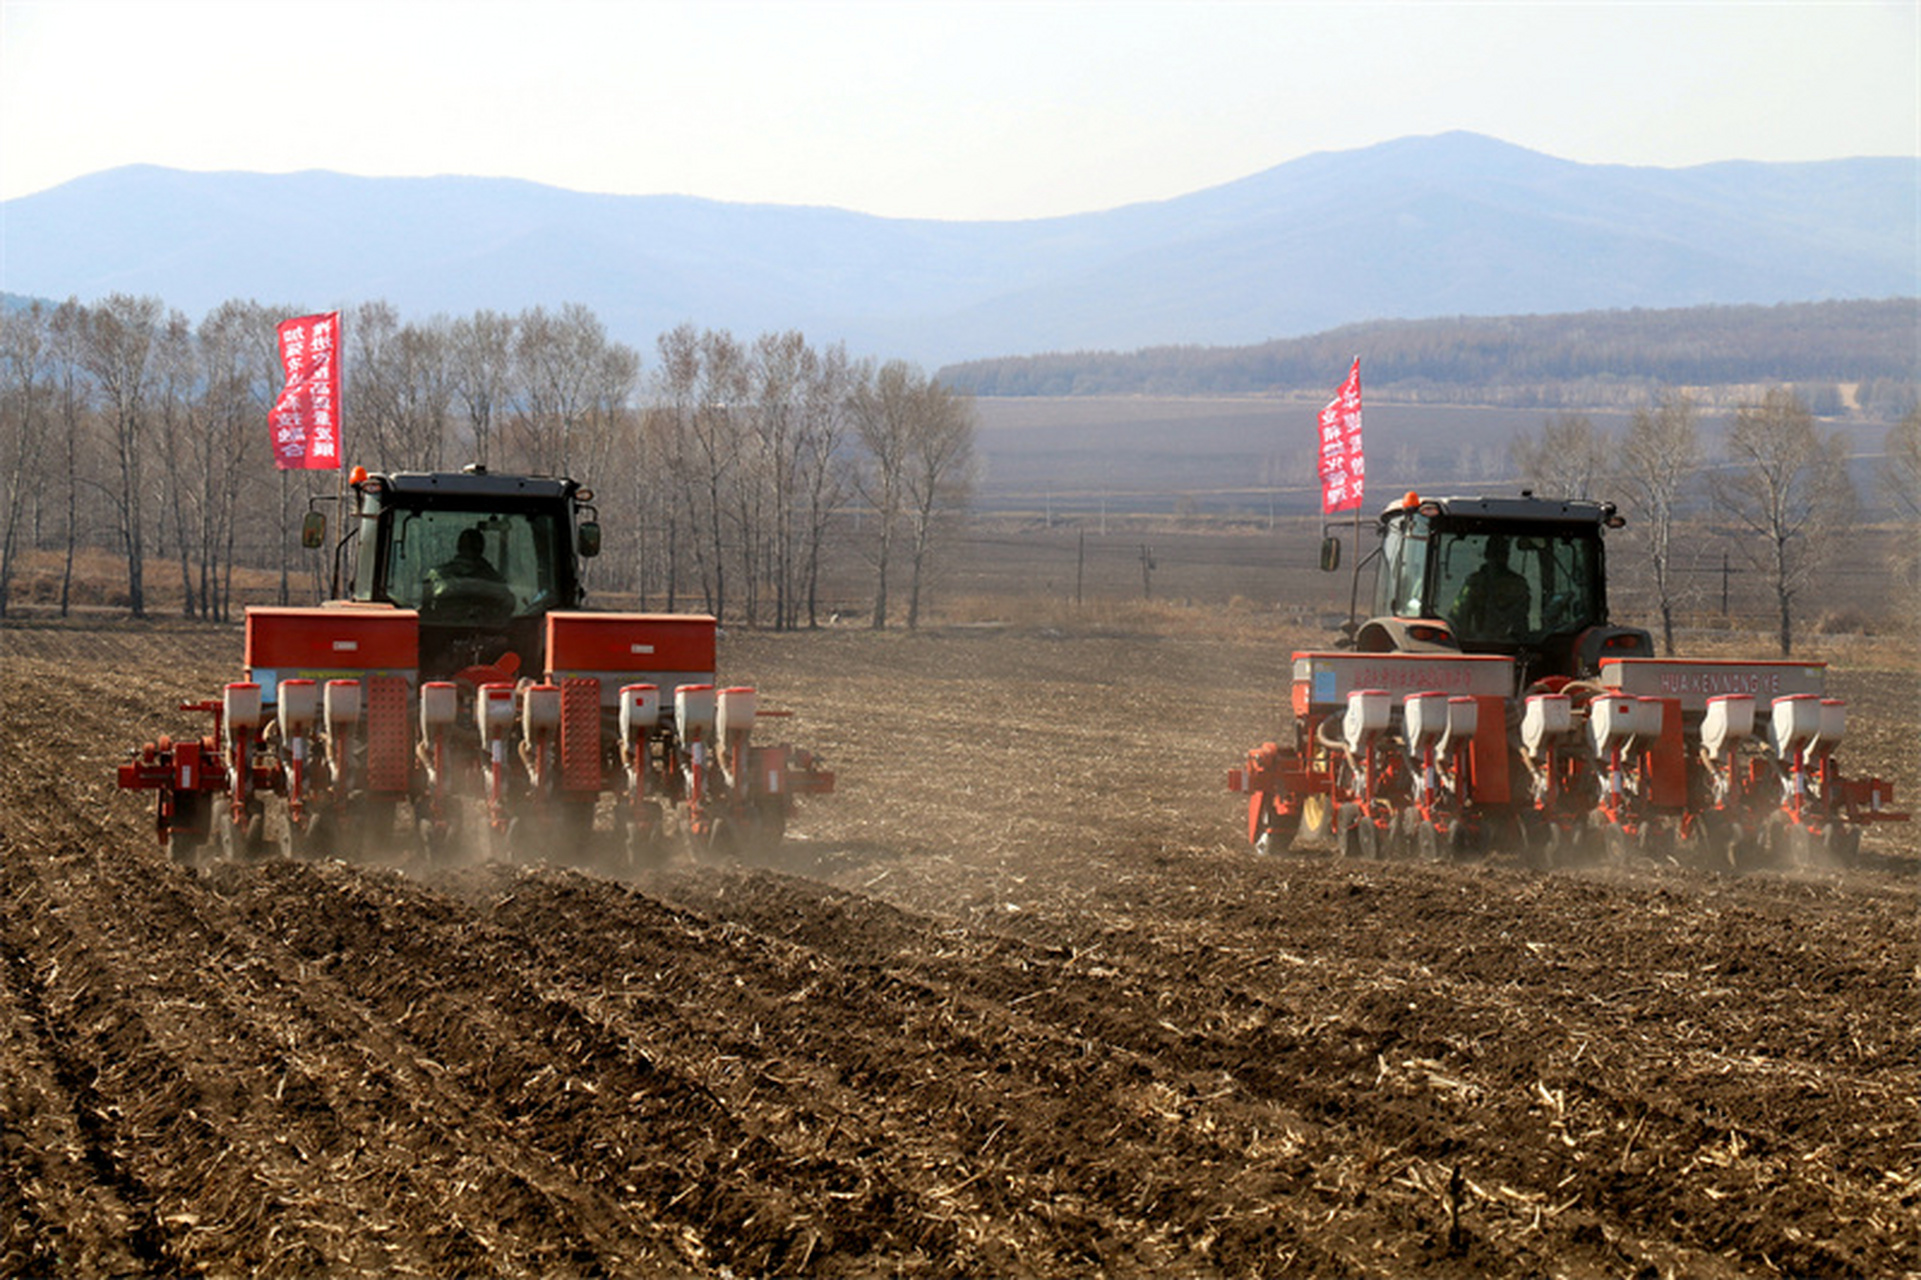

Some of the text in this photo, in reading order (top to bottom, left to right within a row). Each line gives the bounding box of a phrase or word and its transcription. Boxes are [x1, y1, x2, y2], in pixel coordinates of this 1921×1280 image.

[1661, 674, 1688, 693] HUA
[1692, 674, 1719, 693] KEN
[1762, 674, 1779, 693] YE
